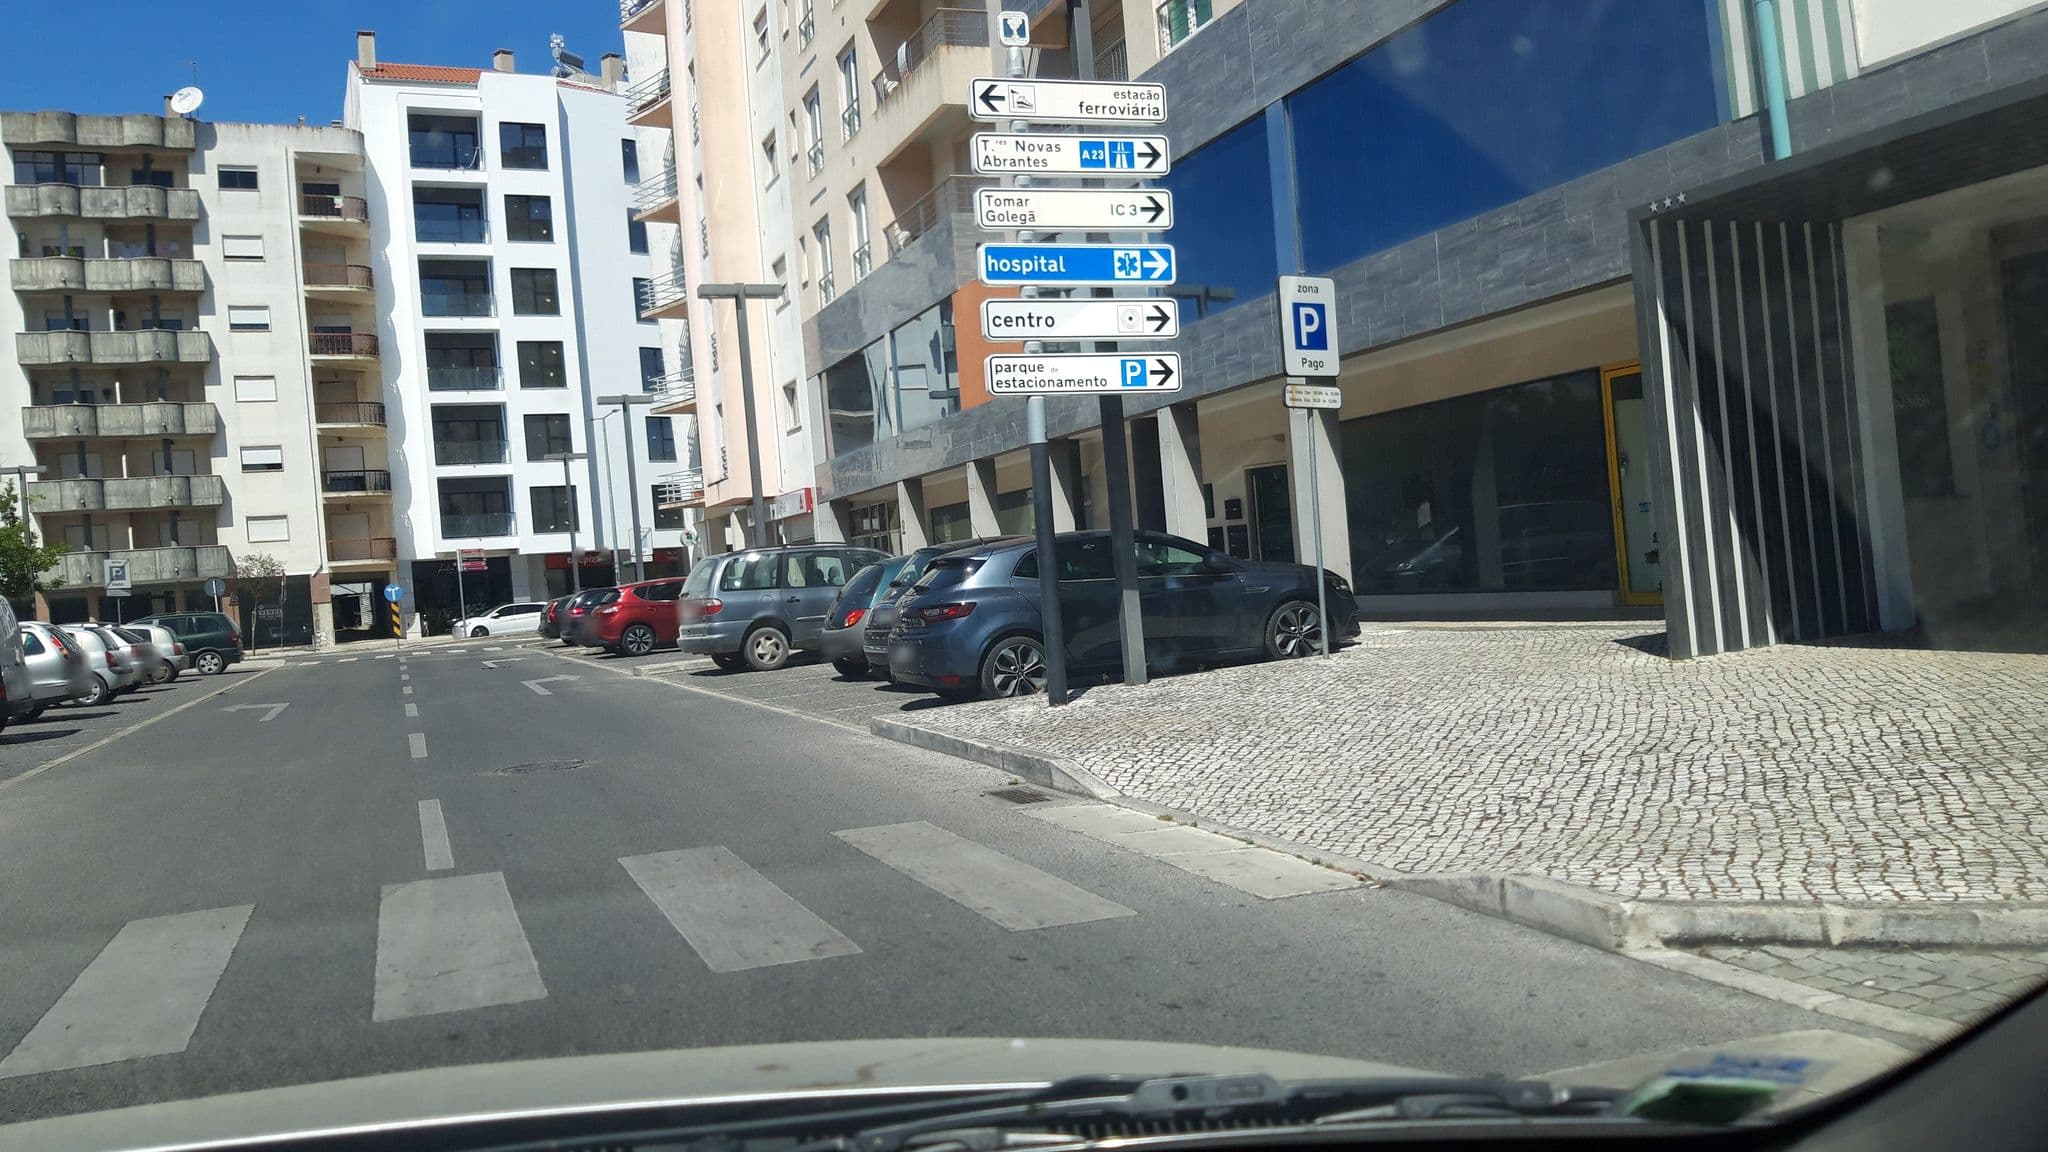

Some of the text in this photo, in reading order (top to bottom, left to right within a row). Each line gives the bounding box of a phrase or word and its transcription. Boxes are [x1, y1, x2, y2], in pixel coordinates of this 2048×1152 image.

[1113, 90, 1160, 102] estação
[1079, 102, 1160, 117] ferroviária
[1015, 140, 1062, 153] Novas
[983, 156, 1048, 168] Abrantes
[985, 195, 1030, 207] Tomar
[986, 210, 1036, 224] Golegã
[1110, 204, 1137, 216] IC 3
[987, 256, 1066, 275] hospital
[1297, 284, 1319, 294] zona
[992, 312, 1055, 328] centro
[1299, 307, 1319, 346] P
[995, 362, 1045, 376] parque
[1301, 357, 1325, 371] Pago
[1125, 361, 1142, 385] P
[996, 375, 1108, 389] estacionamento
